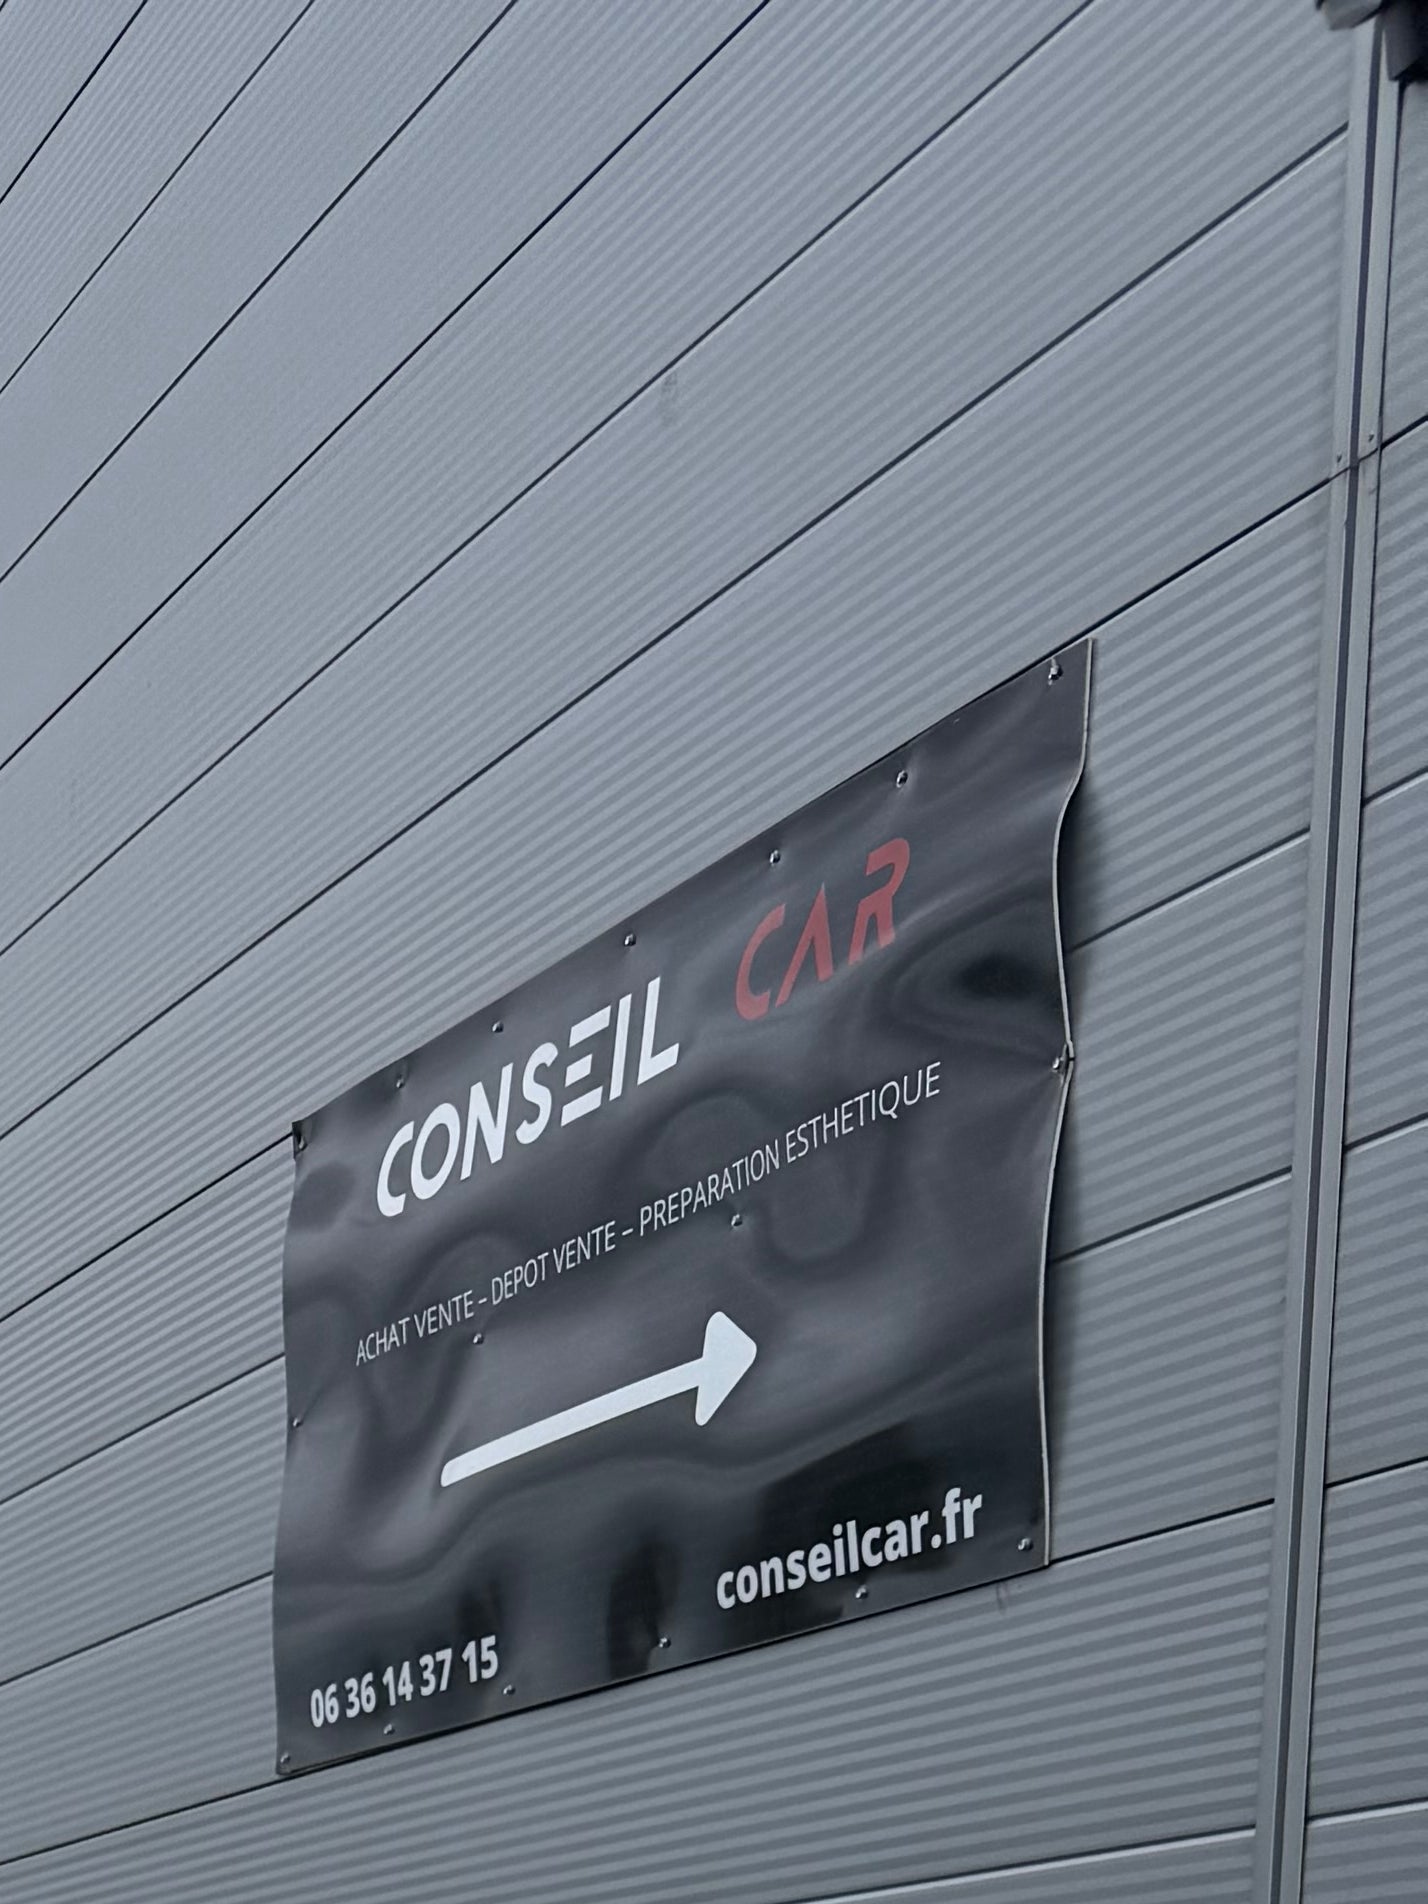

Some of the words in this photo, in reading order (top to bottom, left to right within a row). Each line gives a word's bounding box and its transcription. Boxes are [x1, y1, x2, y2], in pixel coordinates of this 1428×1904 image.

[376, 977, 680, 1217] CONSEIL
[735, 837, 911, 1021] CAR
[355, 1317, 410, 1367] ACHAT
[413, 1289, 475, 1339] VENTE
[491, 1251, 549, 1306] DEPOT
[552, 1220, 616, 1275] VENTE
[639, 1138, 780, 1237] PREPARATION
[785, 1061, 941, 1164] ESTHETIQUE
[716, 1486, 983, 1610] conseilcar.fr
[310, 1682, 340, 1728] 06
[344, 1671, 377, 1719] 36
[382, 1660, 414, 1707] 14
[419, 1648, 453, 1697] 37
[461, 1634, 499, 1684] 15
